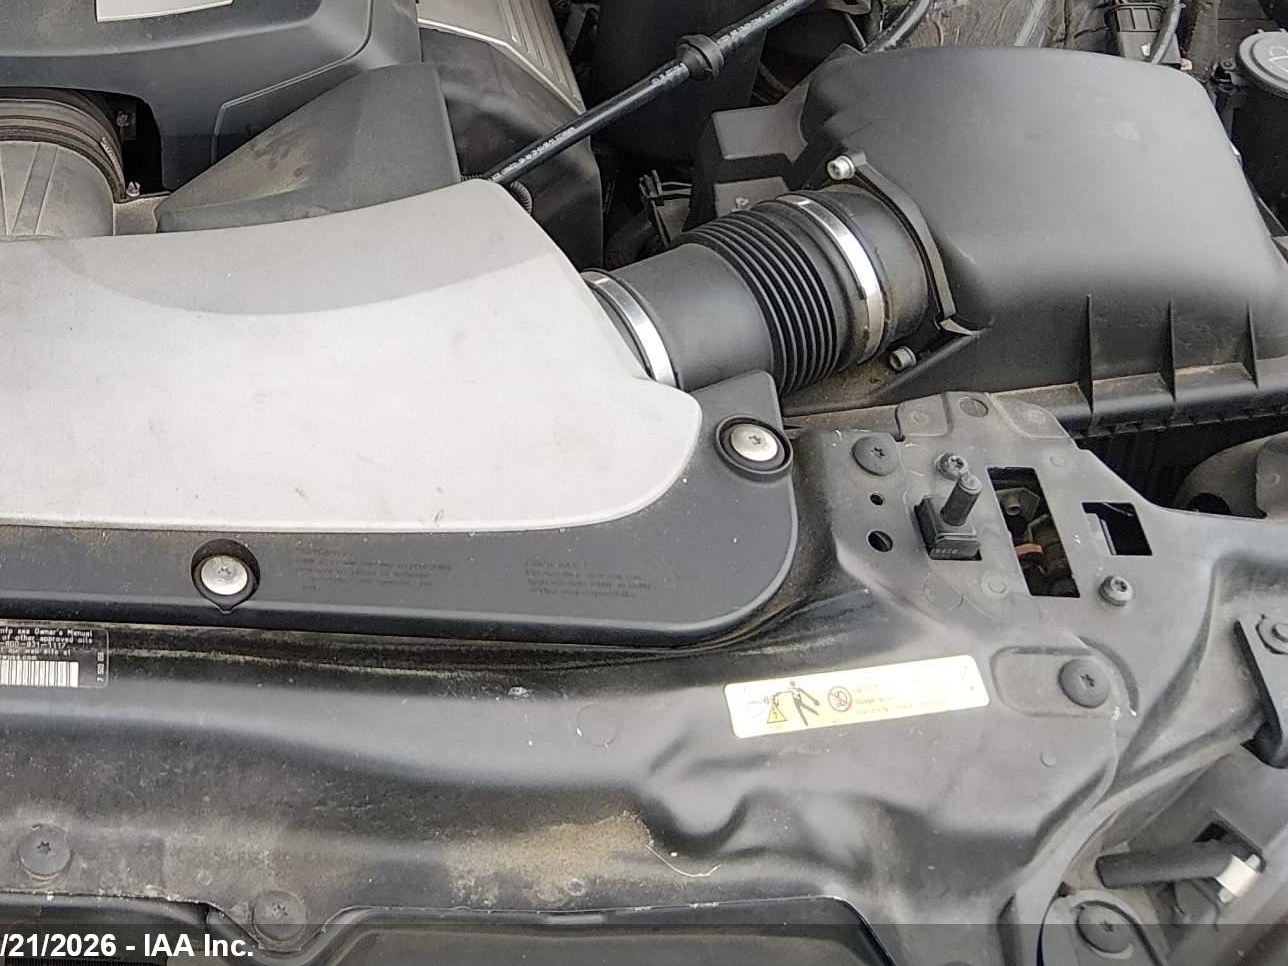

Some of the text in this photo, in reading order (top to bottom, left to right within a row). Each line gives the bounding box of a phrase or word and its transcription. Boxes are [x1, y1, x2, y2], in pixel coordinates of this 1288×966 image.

[67, 628, 93, 637] Manual
[15, 634, 35, 642] other
[39, 635, 74, 644] approved
